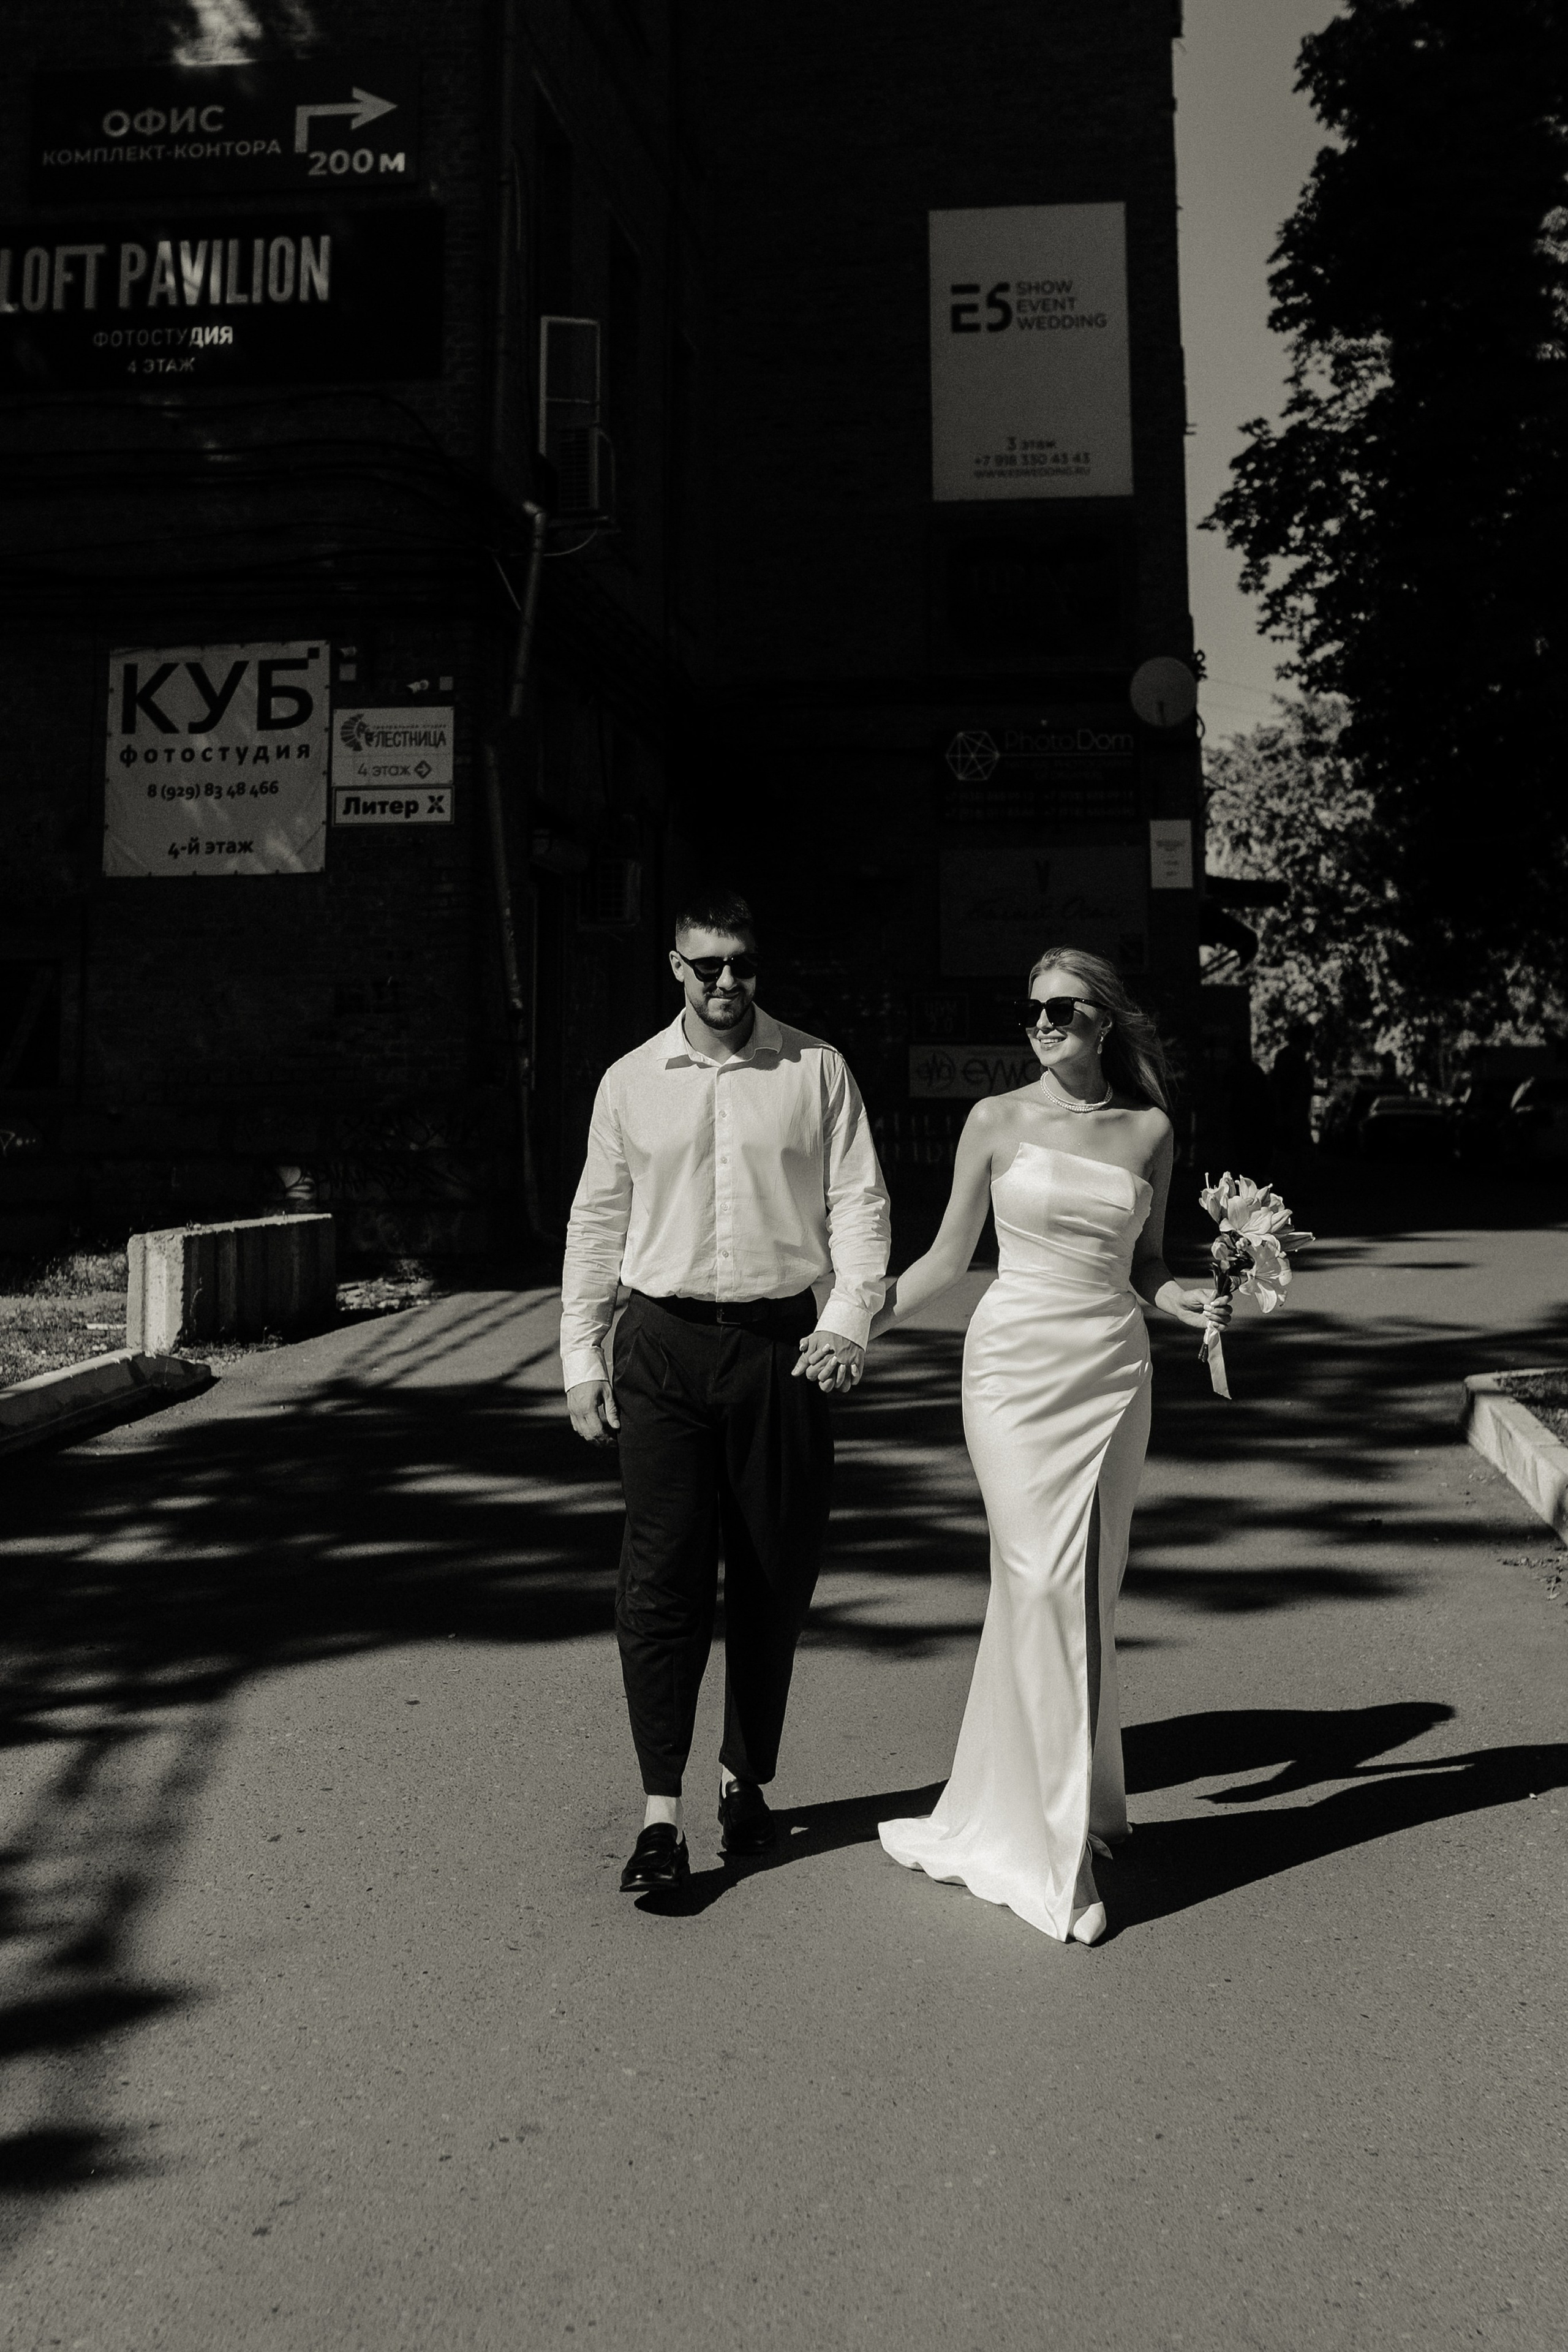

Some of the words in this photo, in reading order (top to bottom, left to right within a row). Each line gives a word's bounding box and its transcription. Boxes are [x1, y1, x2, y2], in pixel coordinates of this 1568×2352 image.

[103, 105, 225, 138] ОФИС
[43, 139, 282, 165] КОМПЛЕКТ-КОНТОРА
[309, 148, 374, 176] 200
[0, 244, 107, 314] LOFT
[117, 235, 331, 311] PAVILION
[1016, 281, 1073, 296] SHOW
[1016, 297, 1076, 313] EVENT
[1016, 312, 1107, 331] WEDDING
[92, 325, 233, 348] ФОТОСТУДИЯ
[127, 360, 137, 374] 4
[142, 356, 196, 374] ЭТАЖ
[121, 647, 320, 734] КУБ
[374, 730, 447, 748] ЛЕСТНИЦА
[1005, 728, 1134, 751] PhotoDom
[119, 744, 311, 768] фотостудия
[357, 763, 368, 777] 4
[372, 766, 411, 777] этаж
[148, 784, 157, 798] 8
[161, 783, 201, 802] (929)
[205, 783, 223, 800] 83
[227, 782, 246, 799] 48
[250, 780, 279, 798] 466
[343, 797, 420, 819] Литер
[168, 837, 200, 859] 4-й
[205, 840, 254, 856] этаж
